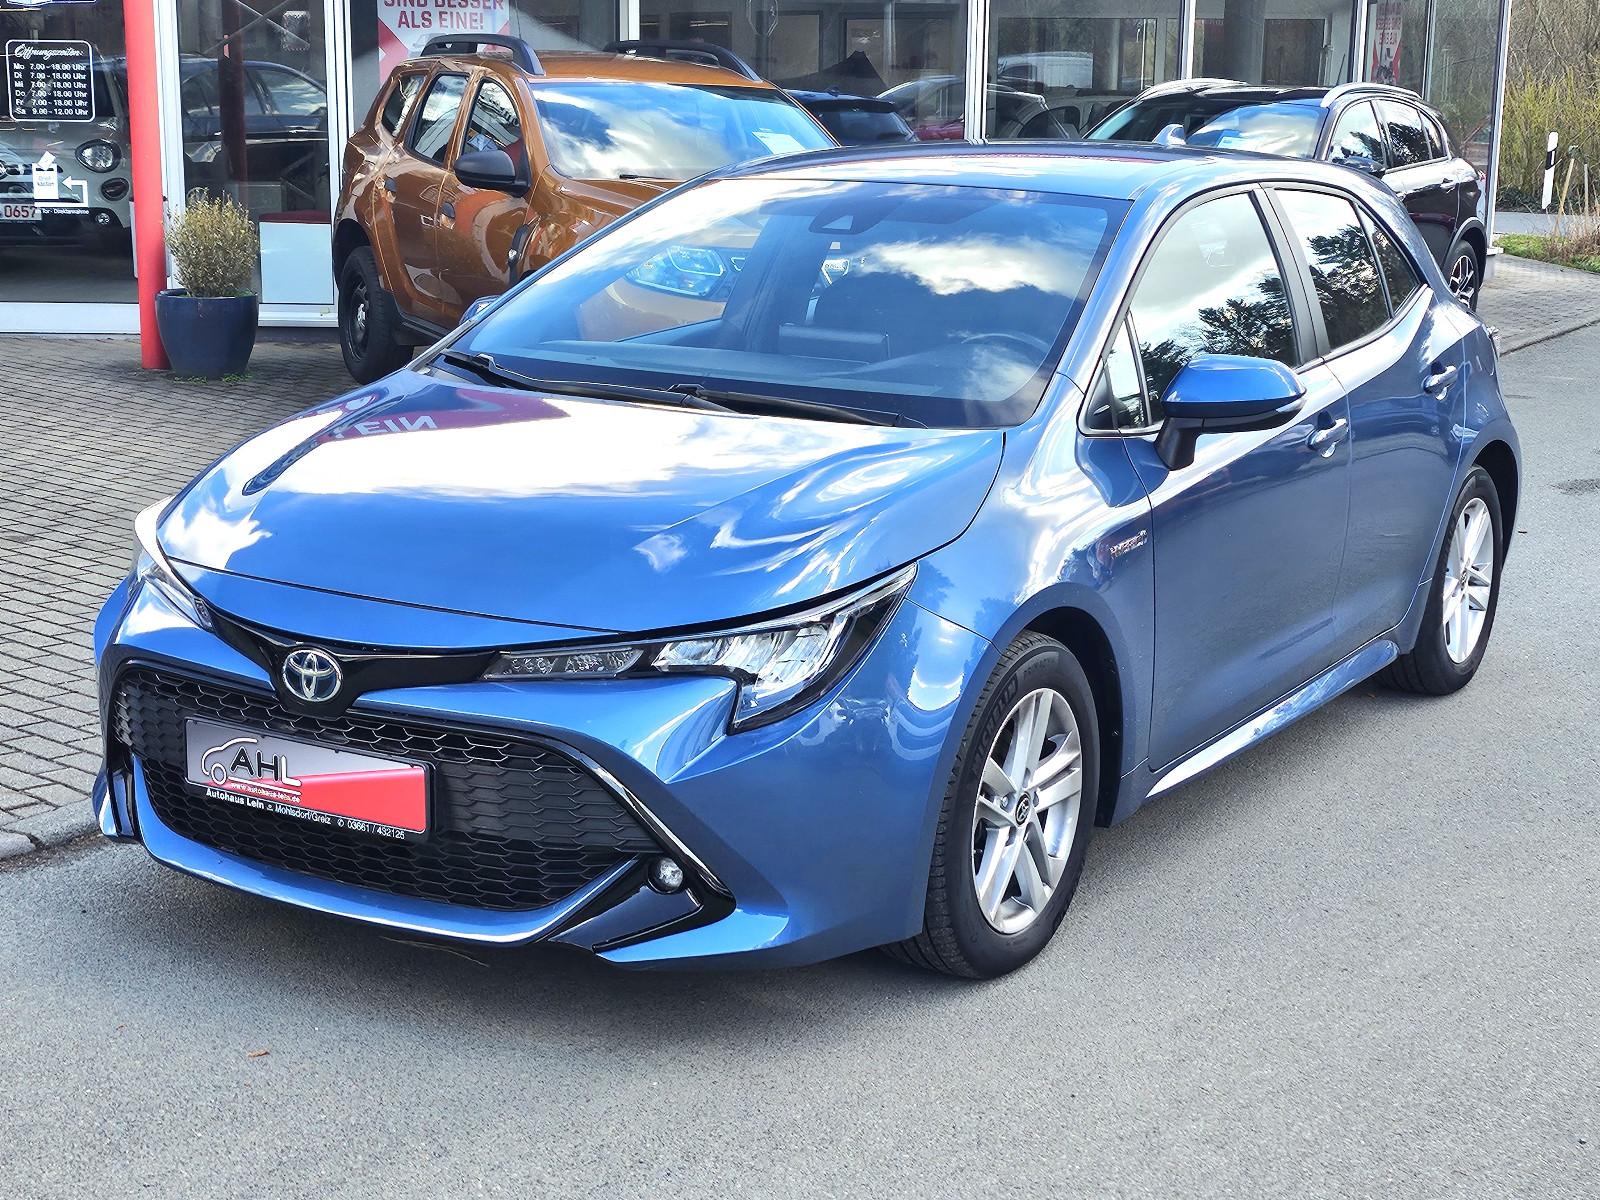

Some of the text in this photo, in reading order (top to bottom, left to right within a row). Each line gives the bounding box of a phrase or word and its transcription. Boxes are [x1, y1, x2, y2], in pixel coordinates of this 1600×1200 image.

[398, 10, 484, 30] ALS EINE!
[4, 204, 36, 218] 0657
[230, 746, 302, 788] AHL
[205, 787, 245, 805] Autohaus
[246, 797, 265, 810] Lein
[347, 820, 372, 833] 03661
